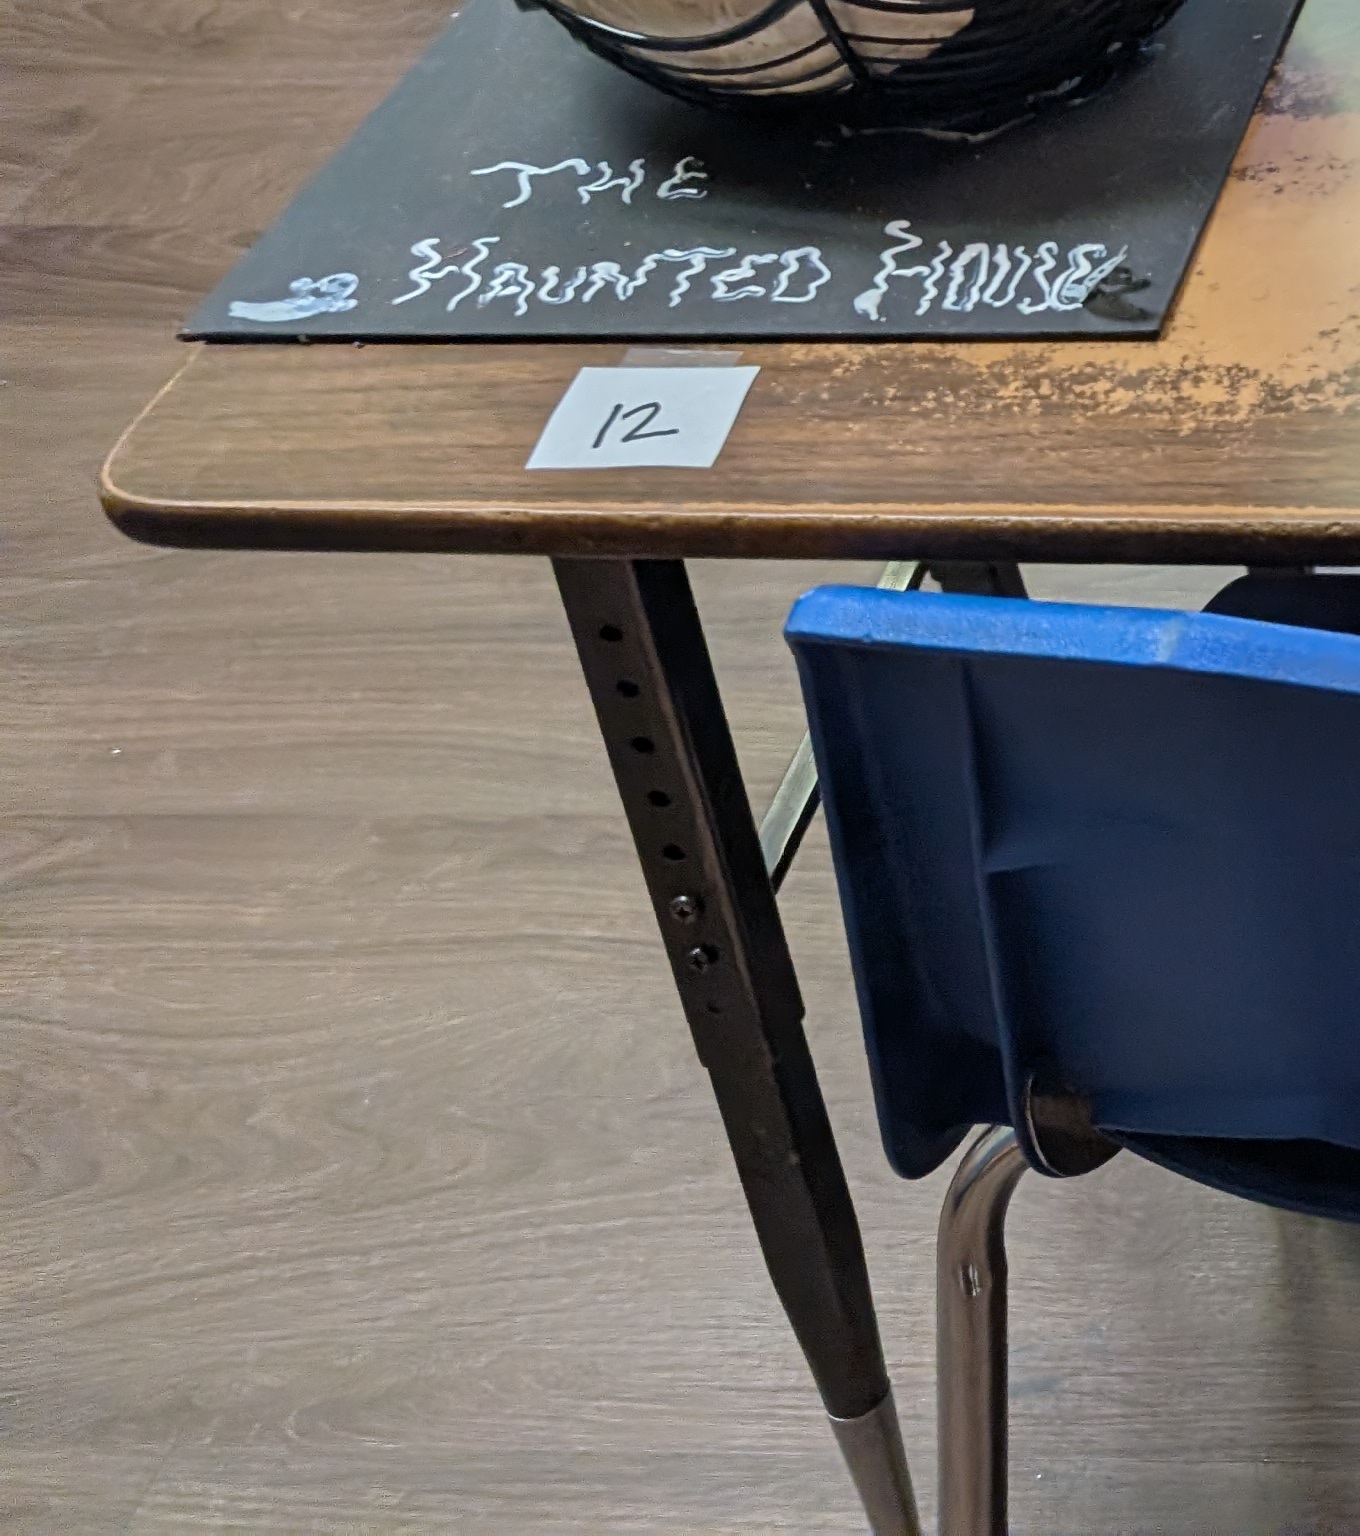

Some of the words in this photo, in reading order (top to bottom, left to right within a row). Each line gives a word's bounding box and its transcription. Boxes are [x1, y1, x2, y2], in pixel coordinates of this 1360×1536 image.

[469, 154, 710, 209] THE
[392, 234, 830, 318] HAUNTED
[590, 399, 679, 449] 12
